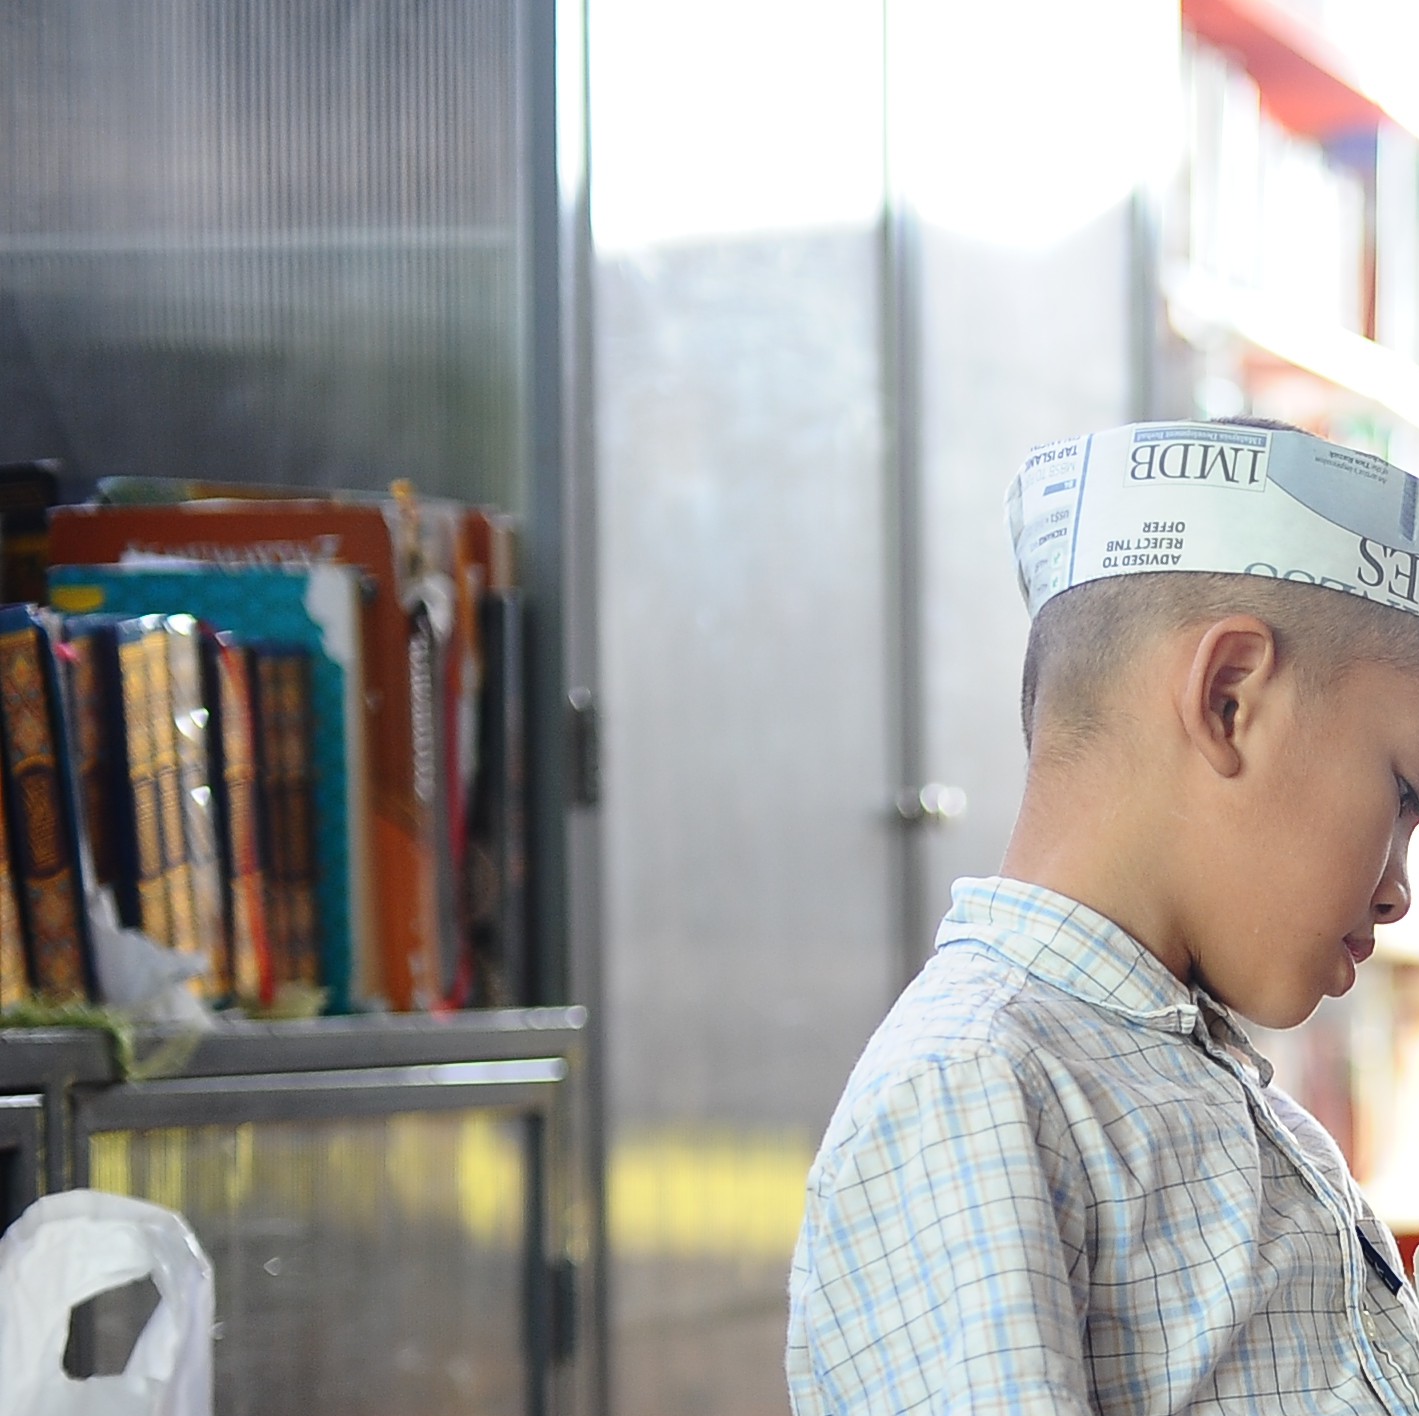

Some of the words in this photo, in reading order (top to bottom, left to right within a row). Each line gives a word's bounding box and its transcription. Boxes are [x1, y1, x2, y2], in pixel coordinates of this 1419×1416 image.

[1129, 443, 1265, 484] 1MDB
[1313, 454, 1353, 473] impression
[1142, 520, 1185, 533] OFFER
[1135, 537, 1183, 550] REJECT
[1122, 553, 1181, 567] ADVISED
